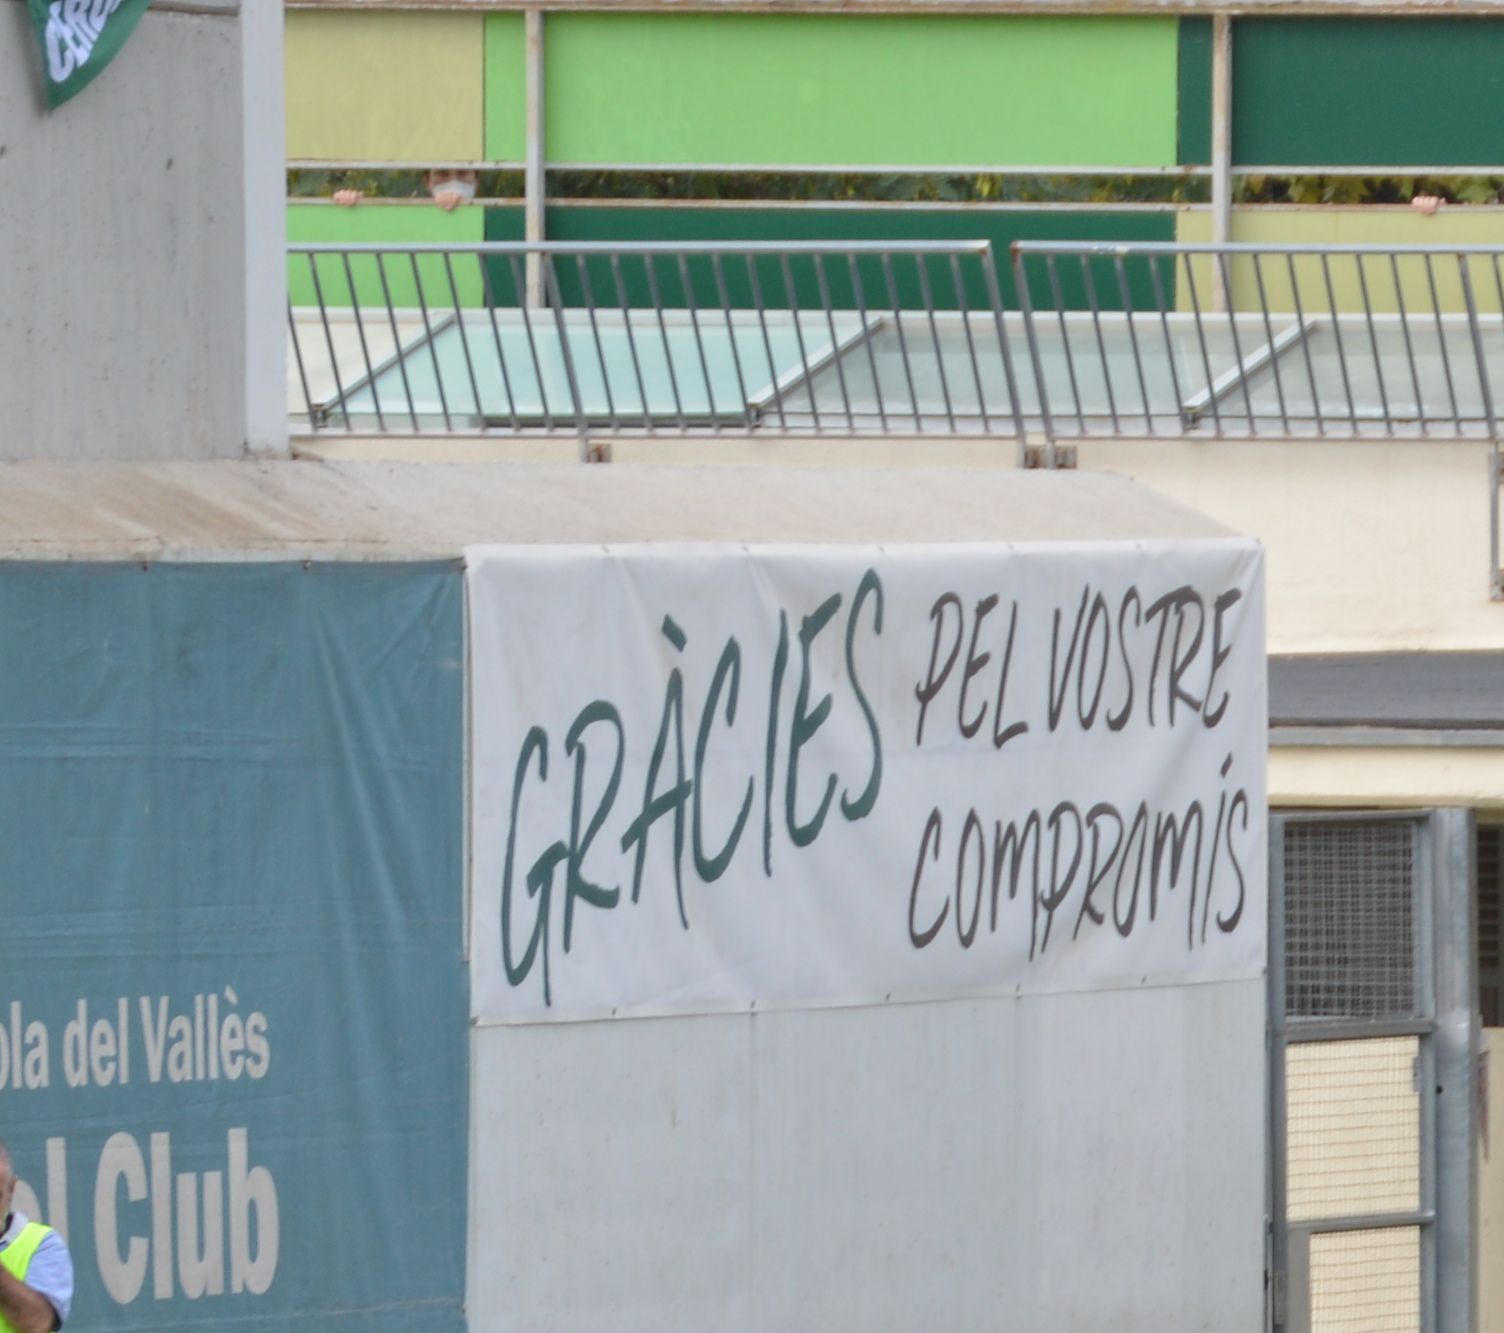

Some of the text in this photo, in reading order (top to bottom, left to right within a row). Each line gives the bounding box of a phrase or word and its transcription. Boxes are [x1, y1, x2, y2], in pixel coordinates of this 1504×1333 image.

[915, 591, 1029, 749] PEL
[1048, 584, 1242, 733] VOSTRE
[63, 998, 128, 1088] del
[141, 985, 271, 1083] Vallès
[95, 1127, 279, 1305] Club
